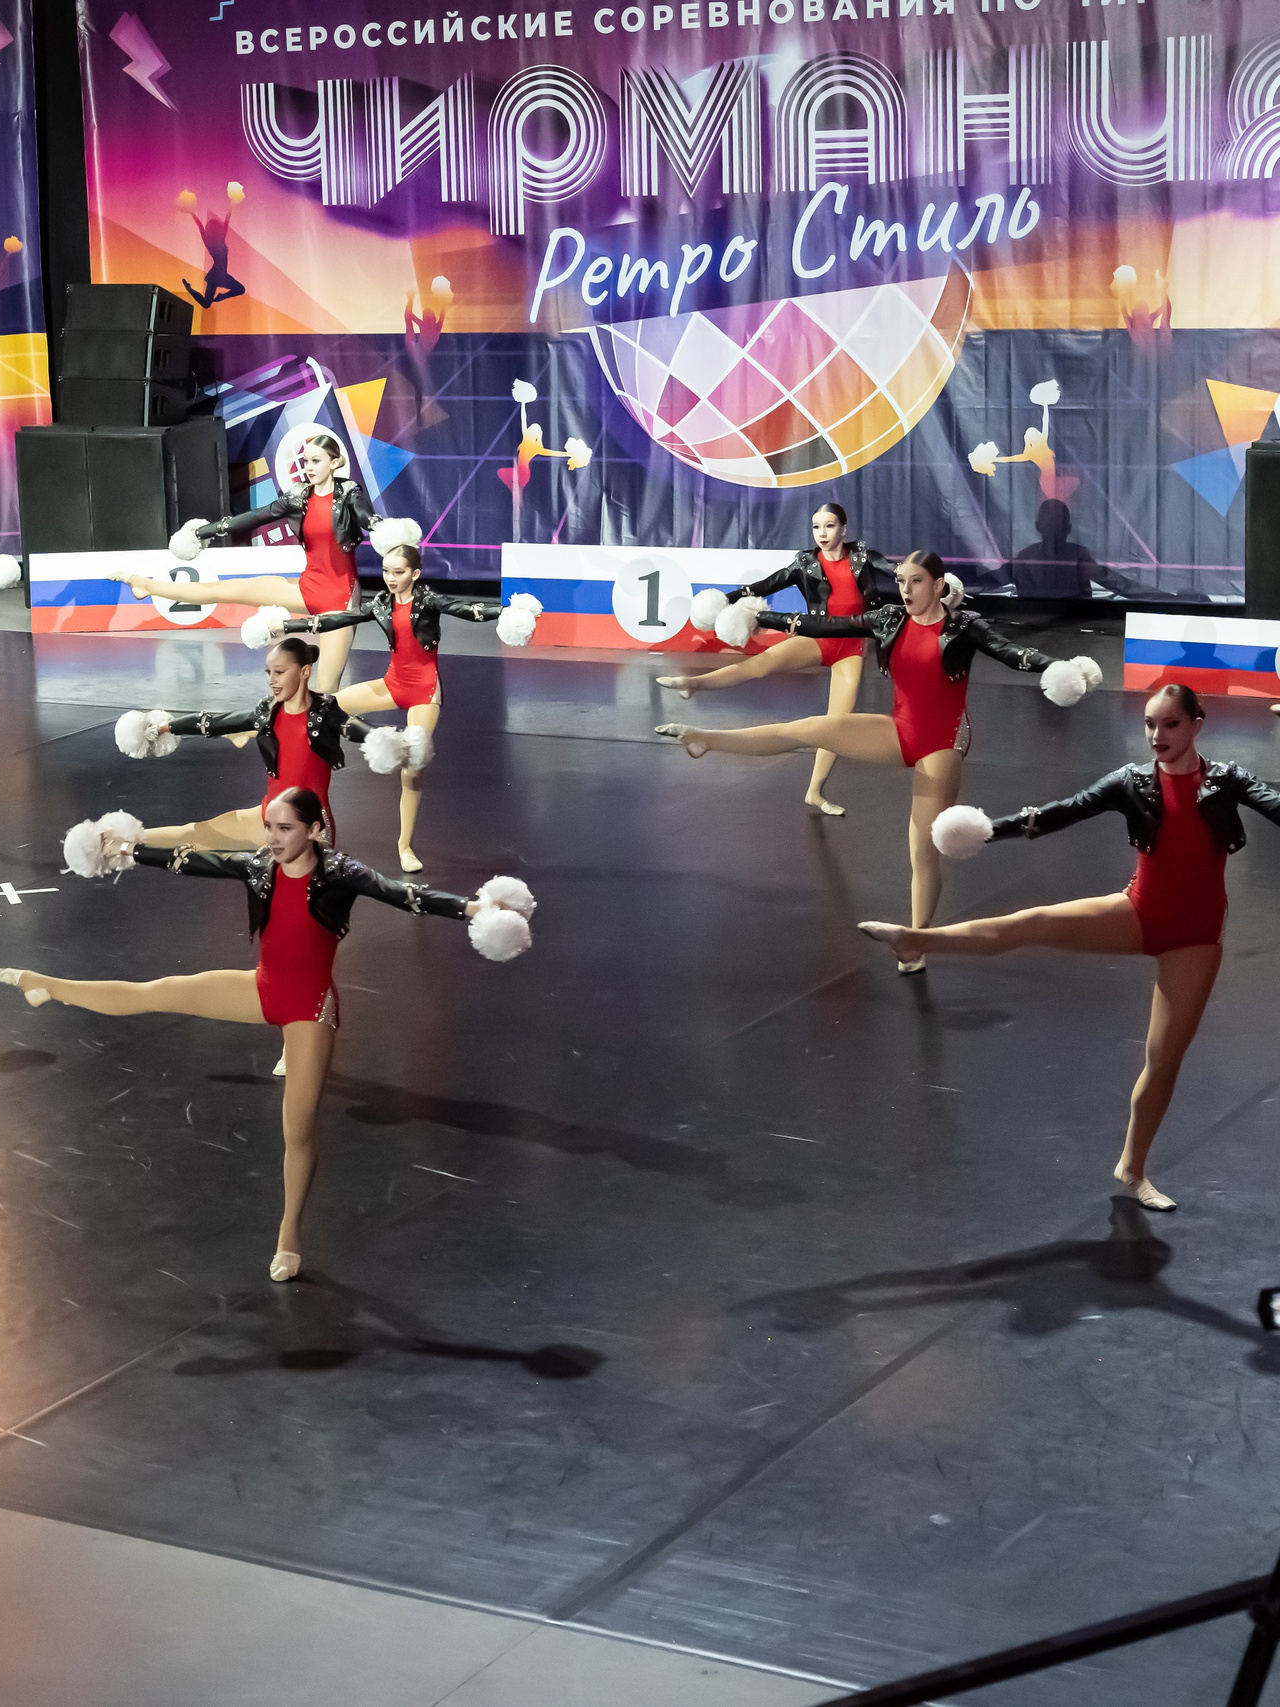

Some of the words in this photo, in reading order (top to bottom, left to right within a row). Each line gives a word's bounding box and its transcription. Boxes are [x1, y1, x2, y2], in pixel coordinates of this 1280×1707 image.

[235, 11, 574, 55] ВСЕРОССИЙСКИЕ
[593, 0, 955, 34] СОРЕВНОВАНИЯ
[529, 226, 759, 323] Ретро
[791, 181, 1040, 279] Стиль
[168, 566, 202, 613] 2
[638, 570, 667, 627] 1
